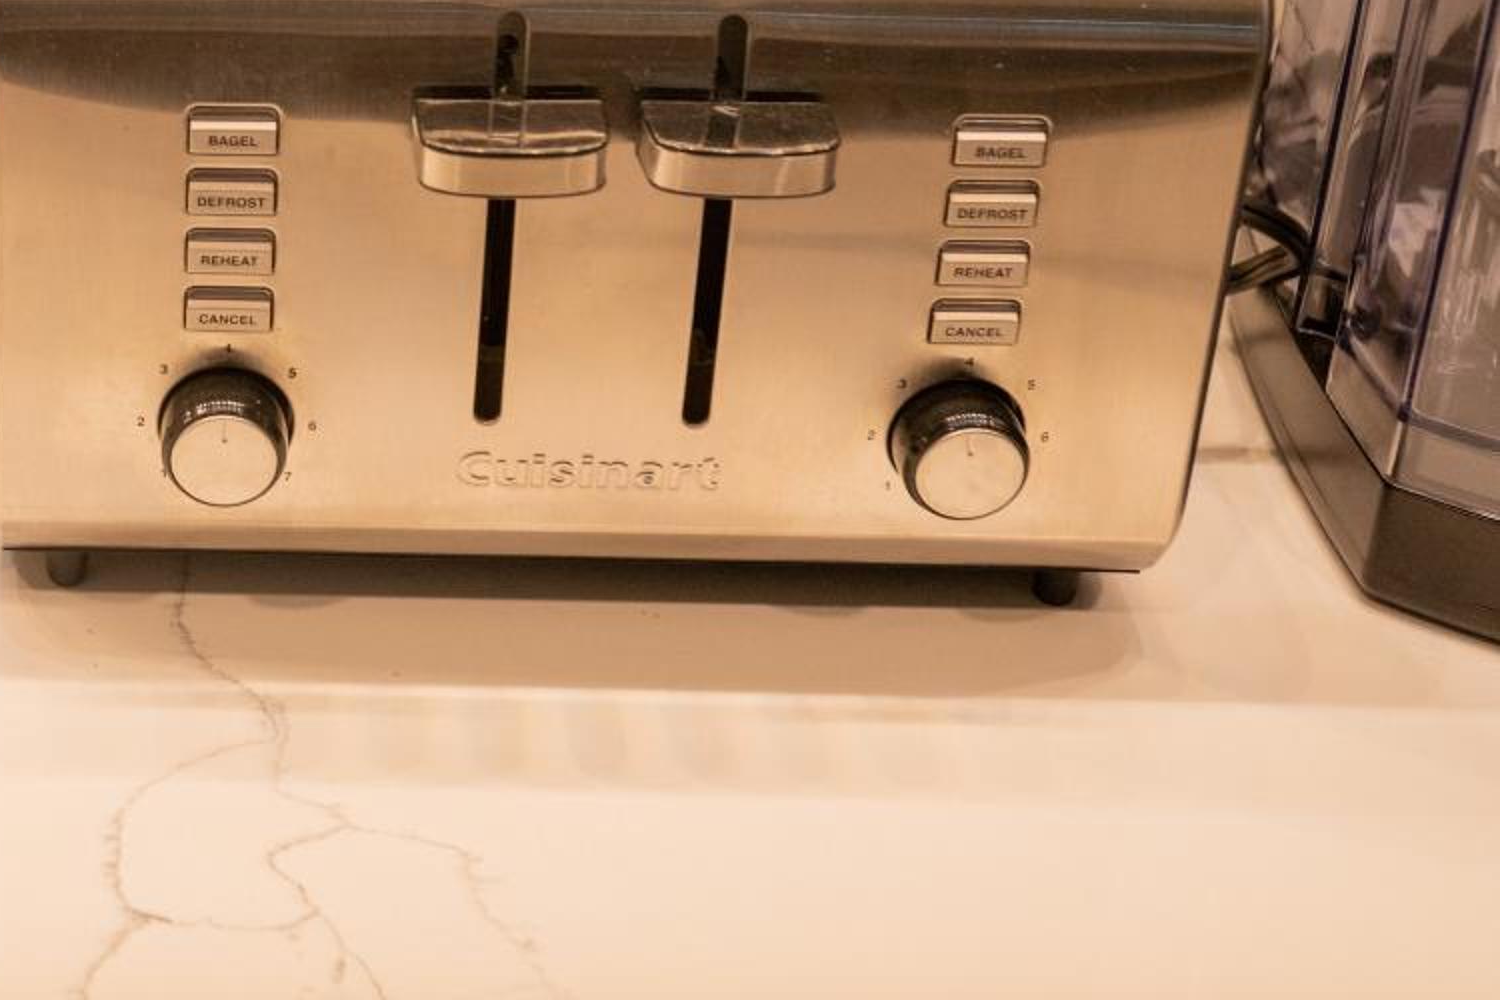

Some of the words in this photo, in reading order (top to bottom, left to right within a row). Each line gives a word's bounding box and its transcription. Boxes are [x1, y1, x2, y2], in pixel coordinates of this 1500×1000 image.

[208, 135, 259, 148] BAGEL
[975, 146, 1027, 160] BAGEL
[197, 196, 266, 209] DEFROST
[957, 208, 1028, 222] DEFROST
[200, 255, 259, 267] REHEAT
[953, 267, 1013, 279] REHEAT
[198, 313, 257, 326] CANCEL
[945, 326, 1004, 338] CANCEL
[159, 363, 168, 375] 3
[287, 366, 297, 379] 5
[137, 416, 145, 428] 2
[283, 471, 292, 482] 7
[456, 450, 722, 490] Cuisinart
